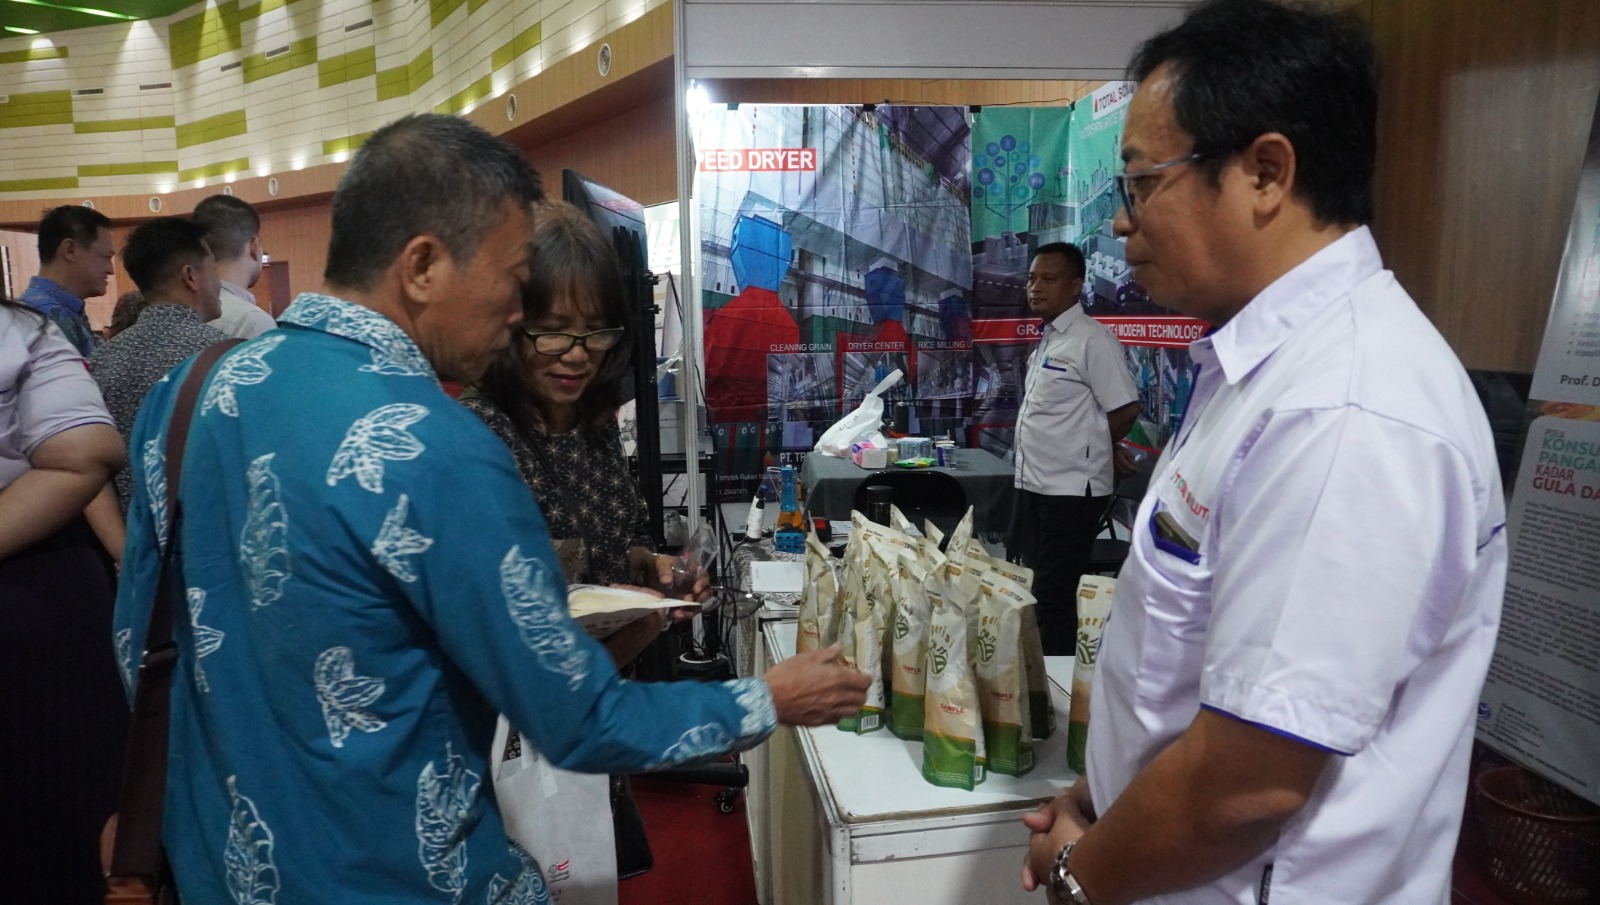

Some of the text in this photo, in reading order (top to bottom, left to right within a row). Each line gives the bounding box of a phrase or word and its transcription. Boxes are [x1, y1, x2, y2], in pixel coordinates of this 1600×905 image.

[1098, 91, 1117, 110] TOTAL
[748, 150, 814, 169] DRYER
[1118, 324, 1146, 337] MODERN
[1147, 324, 1203, 340] TECHNOLOGY
[769, 343, 832, 352] CLEANING GRAIN
[847, 341, 904, 350] DRYER CENTER
[917, 341, 936, 349] RICE
[936, 341, 966, 349] MILLING
[1559, 374, 1589, 386] Prof.
[1544, 428, 1565, 438] POLA
[780, 452, 793, 463] PT.
[1539, 450, 1600, 472] PANGA
[1534, 464, 1575, 481] KADAR
[1532, 476, 1576, 497] GULA
[940, 703, 964, 714] SAMPLE
